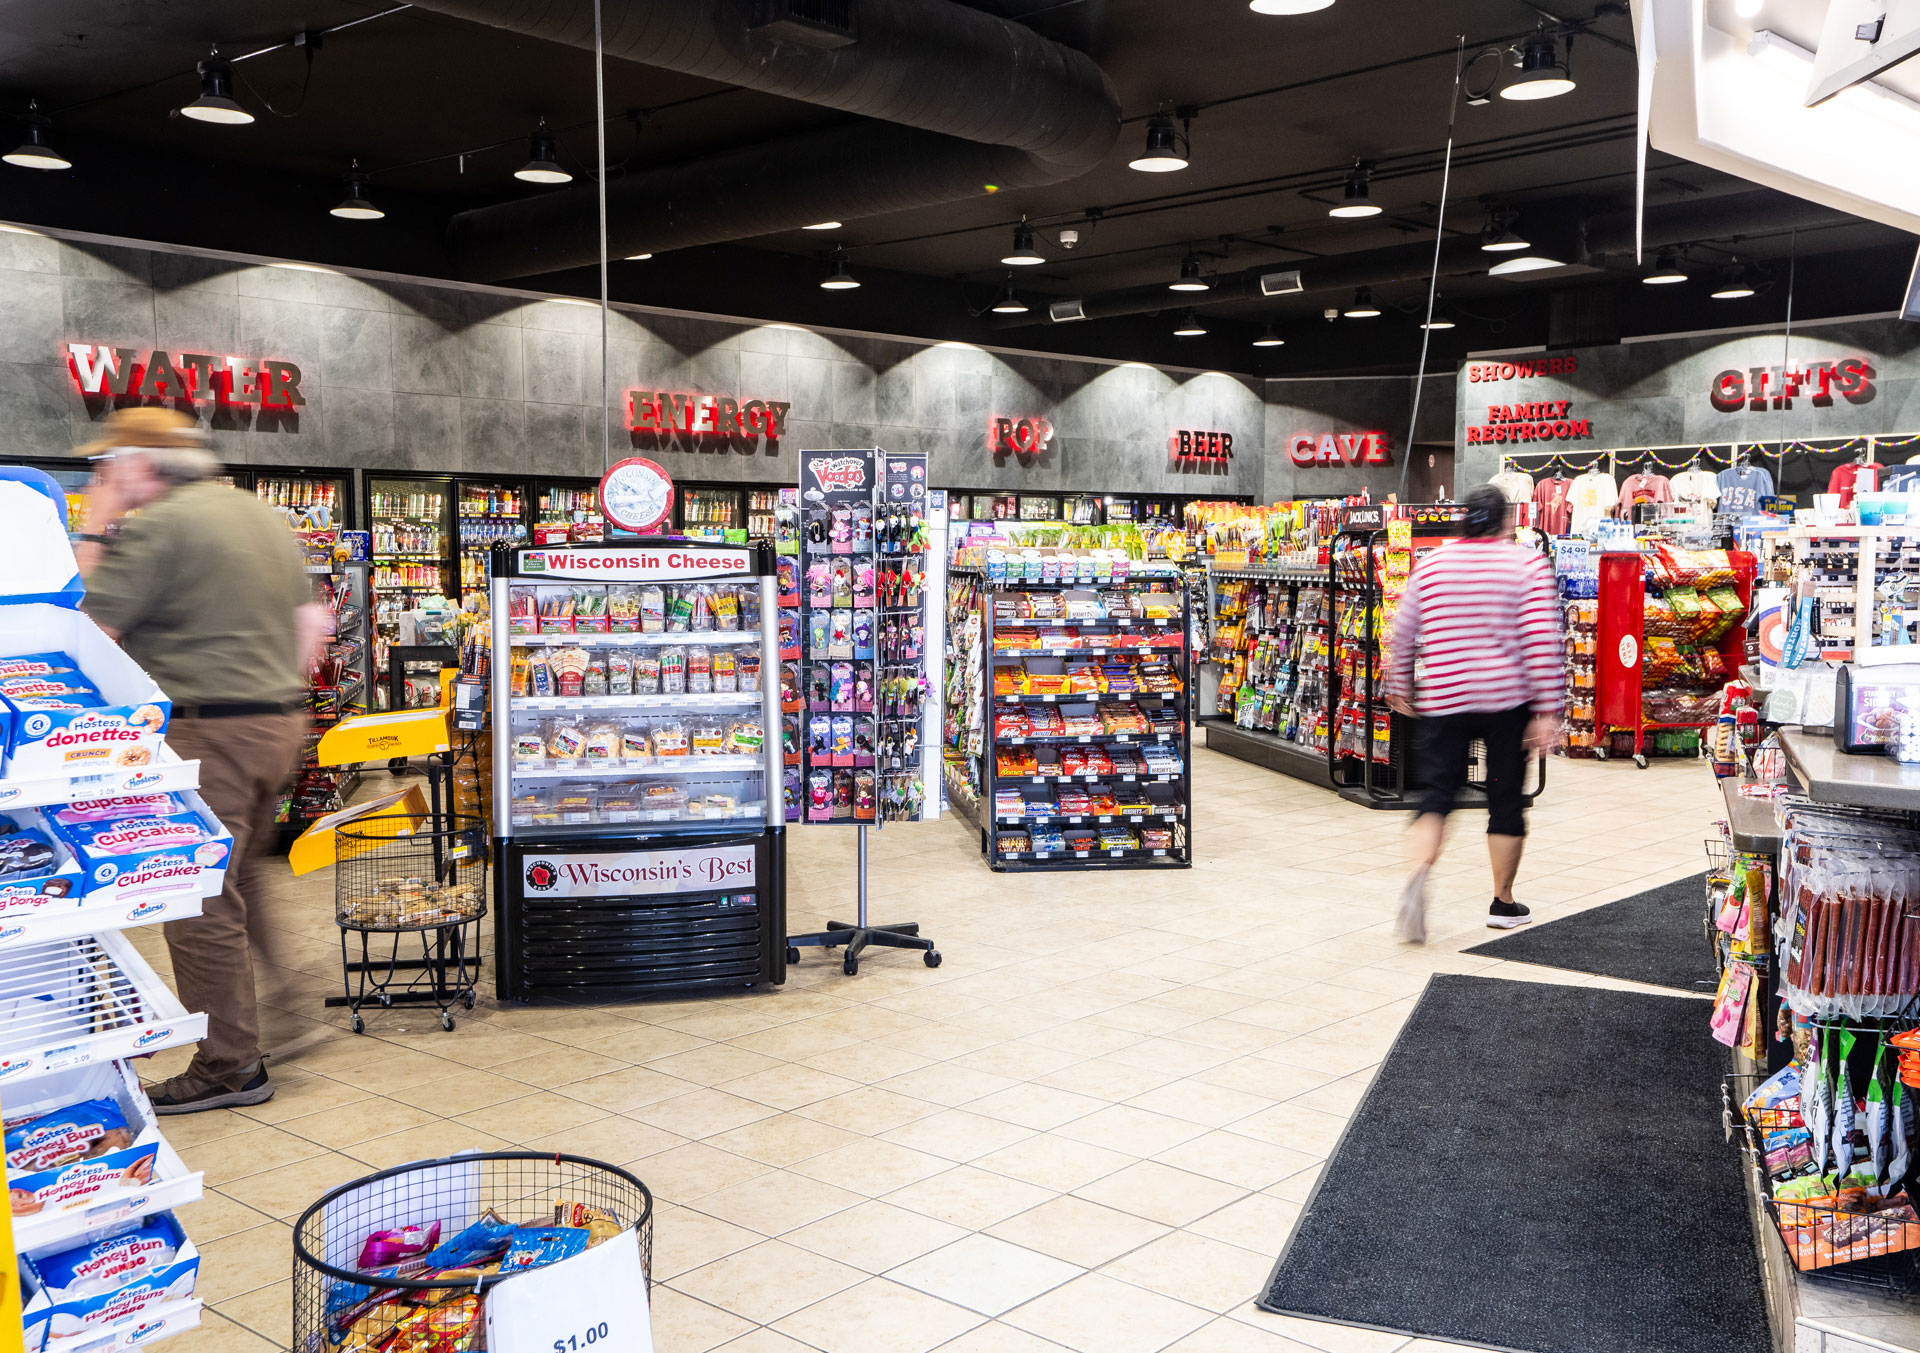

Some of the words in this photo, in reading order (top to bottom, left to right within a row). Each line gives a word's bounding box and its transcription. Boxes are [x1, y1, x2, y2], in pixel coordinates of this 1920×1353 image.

[67, 344, 306, 406] WATER
[1468, 357, 1577, 382] SHOWERS
[1712, 358, 1864, 401] GIFTS
[629, 391, 791, 436] ENERGY
[1487, 400, 1569, 421] FAMILY
[994, 417, 1055, 451] POP
[1466, 419, 1590, 443] RESTROOM
[1178, 430, 1234, 459] BEER
[1290, 434, 1385, 461] CAVE
[1721, 487, 1757, 509] USA
[1560, 546, 1587, 555] $4.99
[547, 553, 660, 570] Wisconsin
[667, 553, 746, 570] Cheese
[0, 664, 46, 674] nettes
[74, 719, 122, 731] Hostess
[46, 728, 142, 748] donettes
[69, 750, 107, 759] CRUNCH
[128, 774, 161, 789] Hostess
[70, 792, 169, 812] Cupcakes
[97, 825, 197, 846] Cupcakes
[117, 820, 167, 832] Hostess
[142, 857, 185, 872] Hostess
[558, 859, 692, 886] Wisconsin's
[698, 856, 753, 884] Best
[117, 865, 202, 889] Cupcakes
[8, 895, 49, 908] Dongs
[132, 902, 165, 917] Hostess
[0, 926, 24, 939] stess
[138, 1029, 171, 1046] Hostess
[11, 1136, 65, 1166] Honey
[65, 1127, 102, 1144] Bun
[27, 1126, 74, 1147] Hostess
[39, 1144, 87, 1166] JUMBO
[38, 1178, 86, 1200] Honey
[87, 1171, 121, 1184] Buns
[61, 1167, 104, 1183] Hostess
[55, 1185, 102, 1203] JUMBO
[93, 1236, 139, 1257] Hostess
[77, 1249, 129, 1277] Honey
[130, 1239, 163, 1255] Bun
[102, 1255, 147, 1279] JUMBO
[85, 1297, 131, 1323] Honey
[132, 1289, 165, 1304] Buns
[108, 1286, 147, 1307] Hostess
[101, 1303, 146, 1324] JUMBO
[131, 1320, 164, 1341] Hostess
[553, 1321, 609, 1353] $1.00
